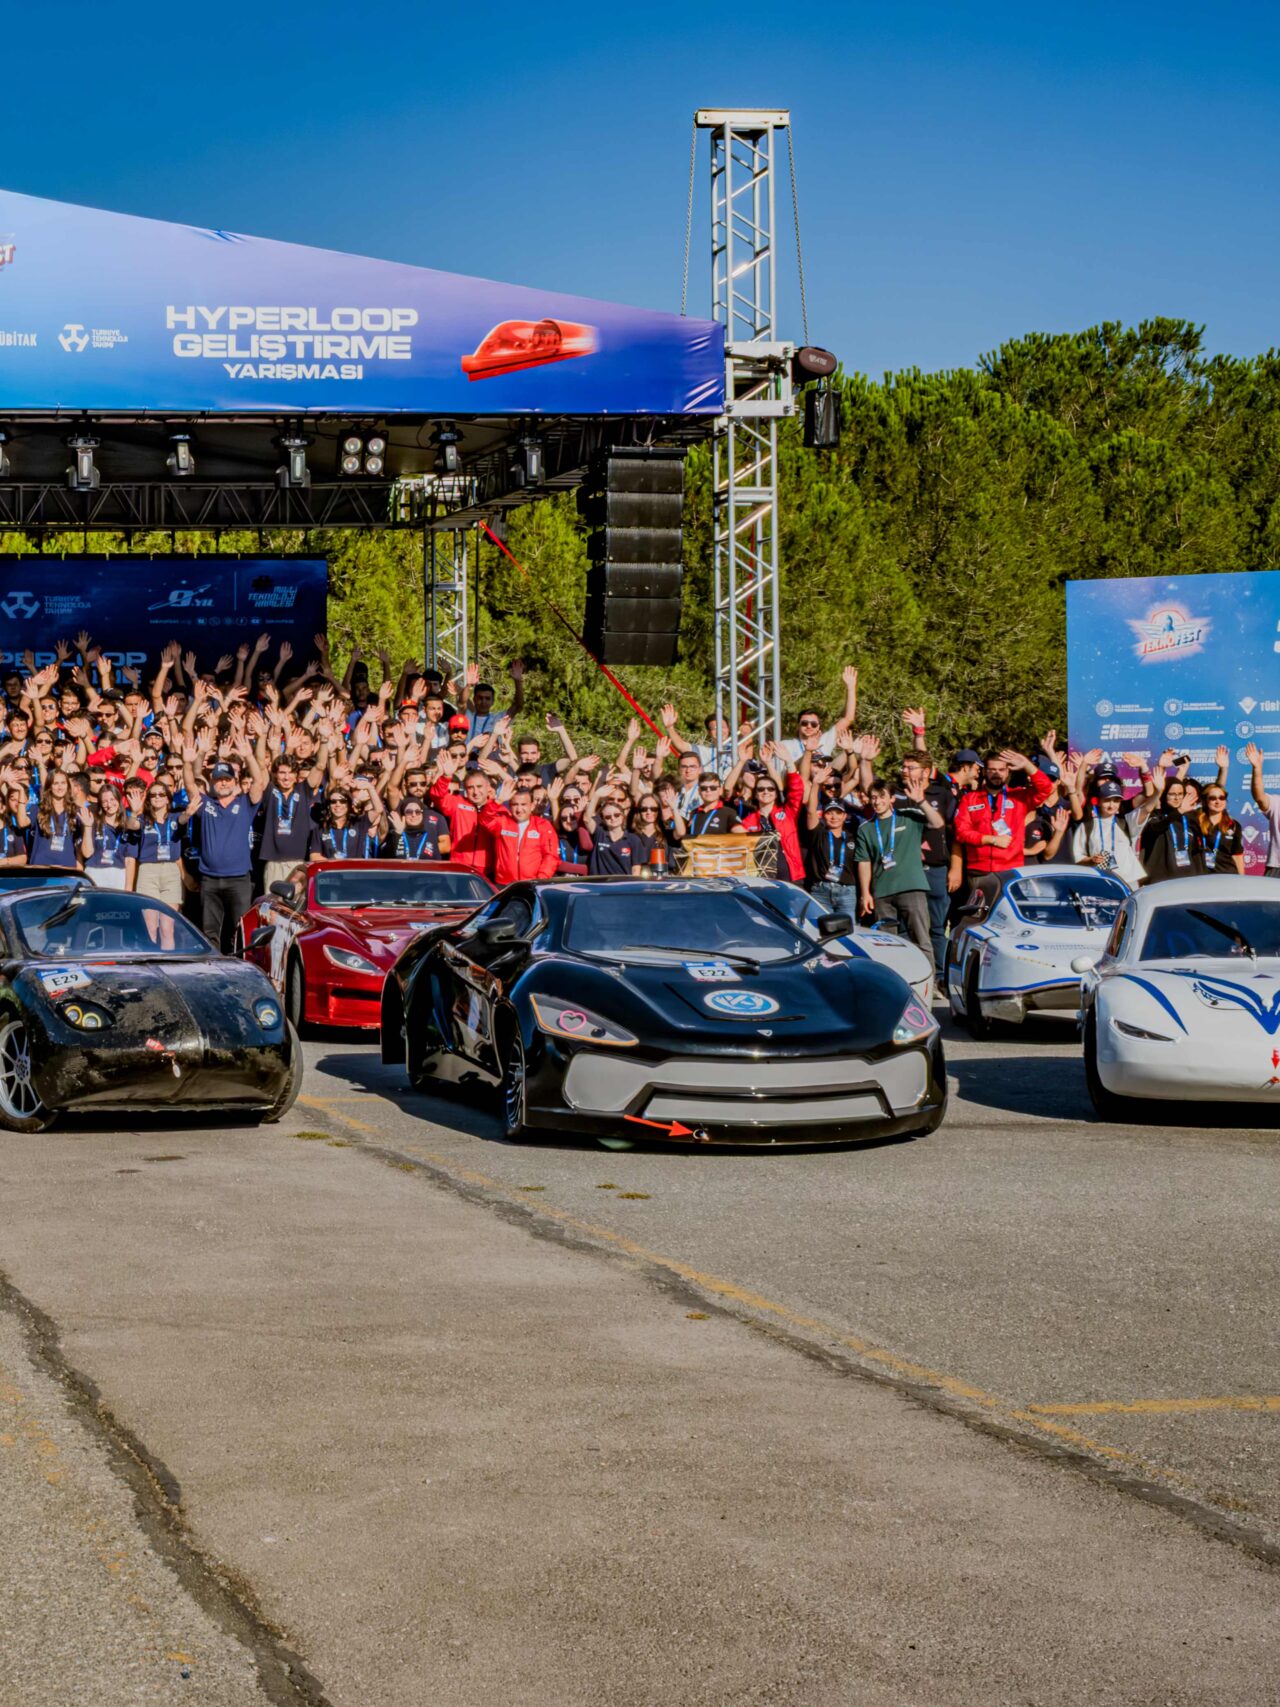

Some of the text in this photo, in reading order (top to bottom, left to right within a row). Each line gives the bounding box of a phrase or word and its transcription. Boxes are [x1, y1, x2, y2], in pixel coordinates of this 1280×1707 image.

[166, 306, 419, 331] HYPERLOOP
[223, 363, 363, 380] YARIŞMASI
[1138, 628, 1201, 654] TEKNOFEST
[52, 974, 79, 987] E29
[698, 969, 730, 977] E22
